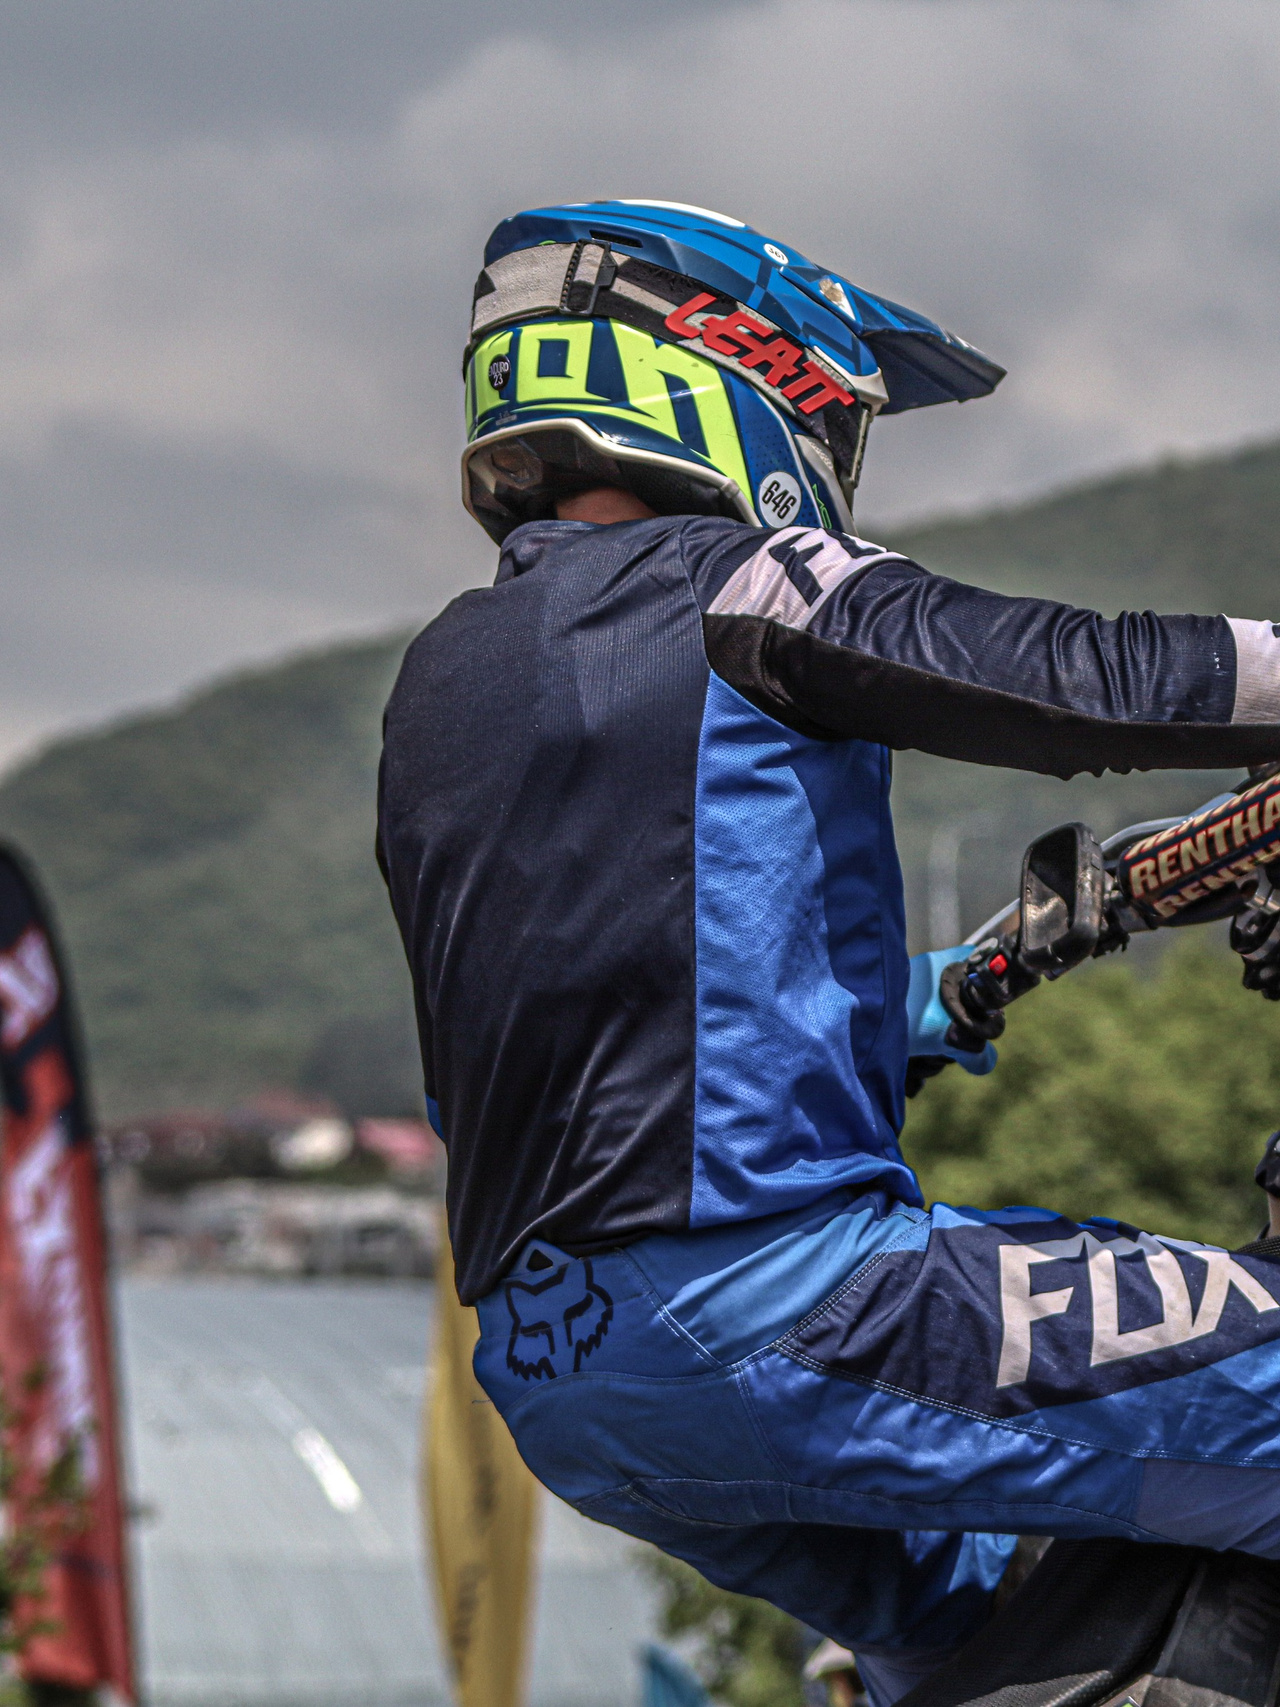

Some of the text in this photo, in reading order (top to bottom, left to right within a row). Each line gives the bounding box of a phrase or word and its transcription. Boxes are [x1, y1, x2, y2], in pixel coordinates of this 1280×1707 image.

[493, 373, 504, 387] 23
[664, 292, 855, 415] LEATT
[761, 480, 798, 520] 646
[996, 1231, 1280, 1389] FOX
